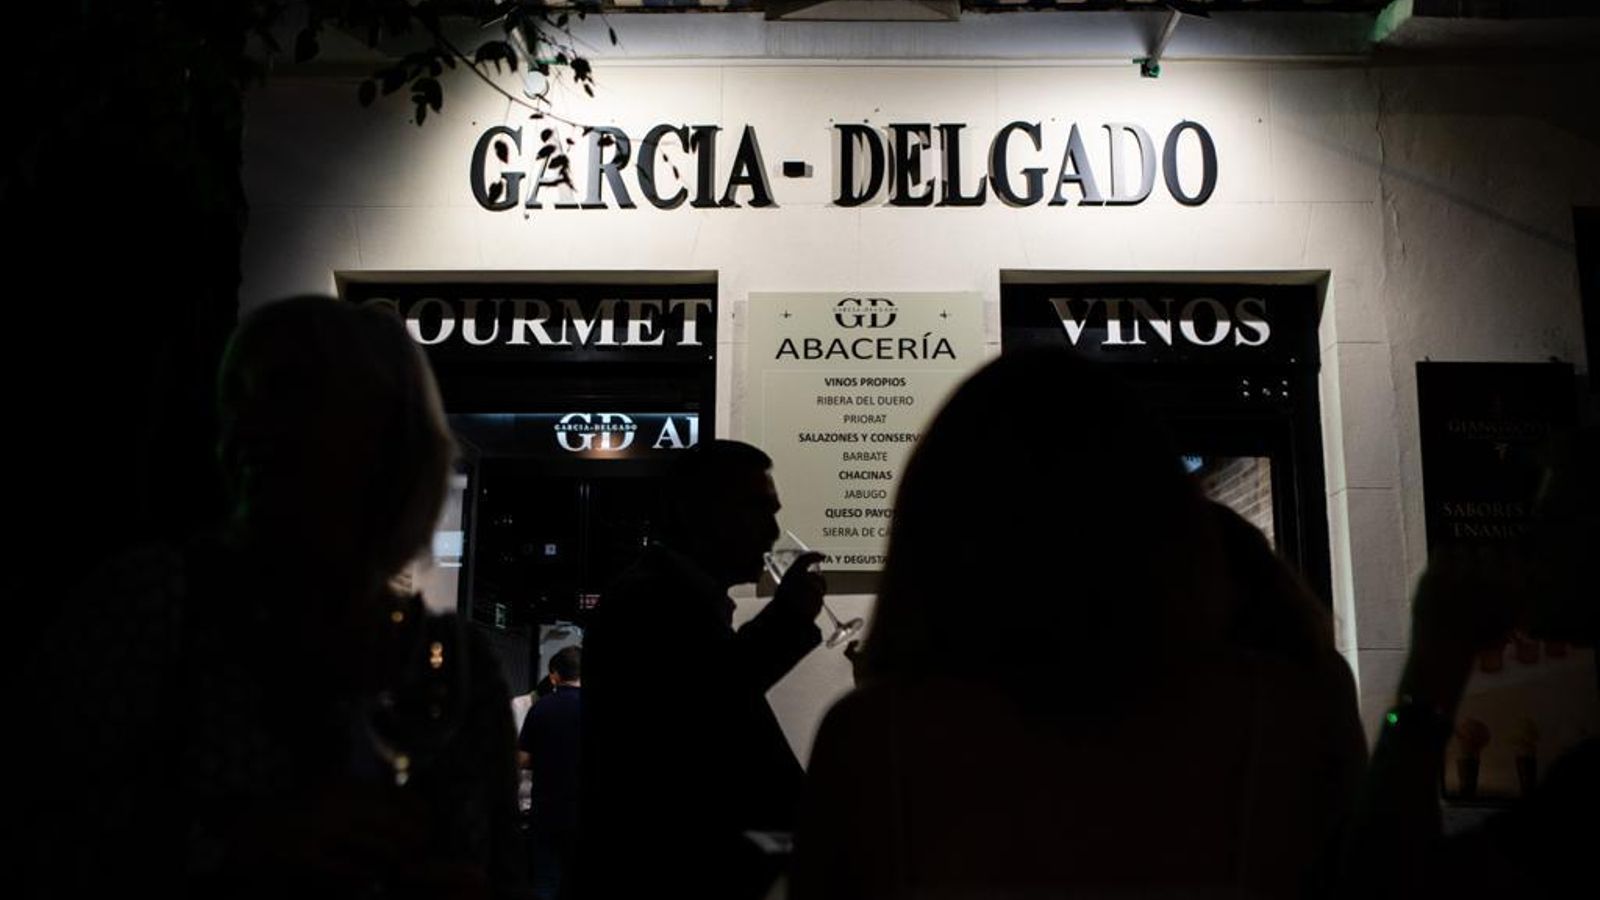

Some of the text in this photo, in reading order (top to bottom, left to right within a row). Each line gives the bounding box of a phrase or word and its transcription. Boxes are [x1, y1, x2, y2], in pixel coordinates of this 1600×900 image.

[470, 123, 776, 211] GARCIA
[830, 120, 1218, 208] DELGADO
[835, 297, 896, 329] GD
[362, 297, 712, 347] OURMET
[1048, 297, 1272, 347] VINOS
[775, 331, 957, 360] ABACERÍA
[824, 377, 907, 387] VINOS PROPIOS
[817, 396, 914, 406] RIBERA DEL DUERO
[843, 414, 887, 424] PRIORAT
[556, 412, 635, 452] GD
[799, 433, 922, 443] SALAZONES Y CONSERV
[843, 452, 888, 462] BARBATE
[838, 471, 893, 481] CHACINAS
[844, 490, 887, 500] JABUGO
[825, 508, 894, 519] QUESO PAYO
[822, 527, 859, 538] SIERRA
[861, 527, 876, 538] DE
[835, 555, 842, 565] Y
